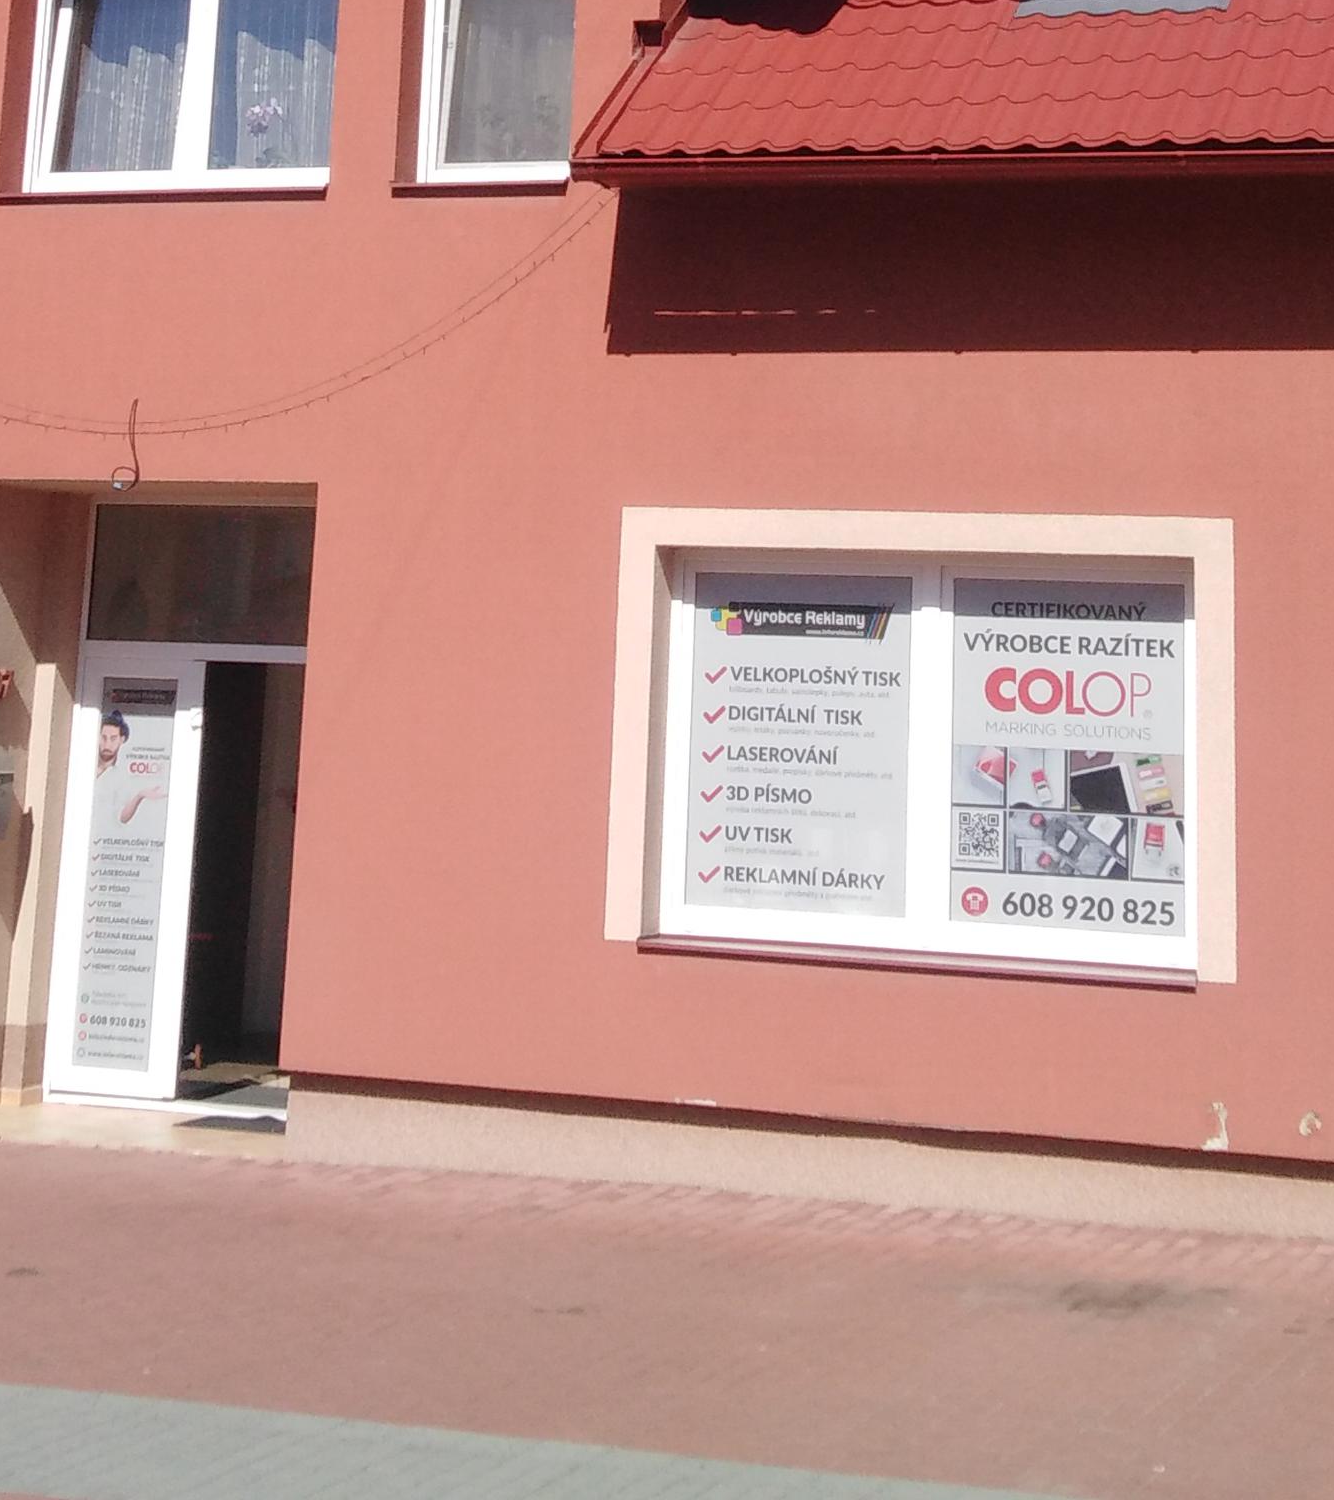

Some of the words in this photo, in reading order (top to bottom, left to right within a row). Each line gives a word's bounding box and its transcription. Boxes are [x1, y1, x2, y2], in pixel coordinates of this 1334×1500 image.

[743, 609, 802, 626] Výrobce
[805, 611, 866, 629] Reklamy
[991, 601, 1147, 620] CERTIFIKOVANÝ
[964, 628, 1072, 654] VÝROBCE
[1078, 633, 1175, 658] RAZÍTEK
[731, 665, 859, 685] VELKOPLOŠNÝ
[862, 670, 902, 687] TISK
[985, 666, 1152, 717] COLOP
[728, 704, 818, 724] DIGITÁLNÍ
[824, 709, 863, 726] TISK
[985, 720, 1057, 736] MARKING
[1063, 724, 1152, 740] SOLUTIONS
[727, 745, 840, 766] LASEROVÁNÍ
[725, 786, 750, 801] 3D
[754, 783, 813, 804] PÍSMO
[725, 825, 750, 842] UV
[754, 827, 793, 844] TISK
[724, 865, 818, 887] REKLAMNÍ
[822, 869, 886, 891] DÁRKY
[1002, 891, 1054, 918] 608
[1061, 895, 1114, 922] 920
[1122, 898, 1175, 926] 825
